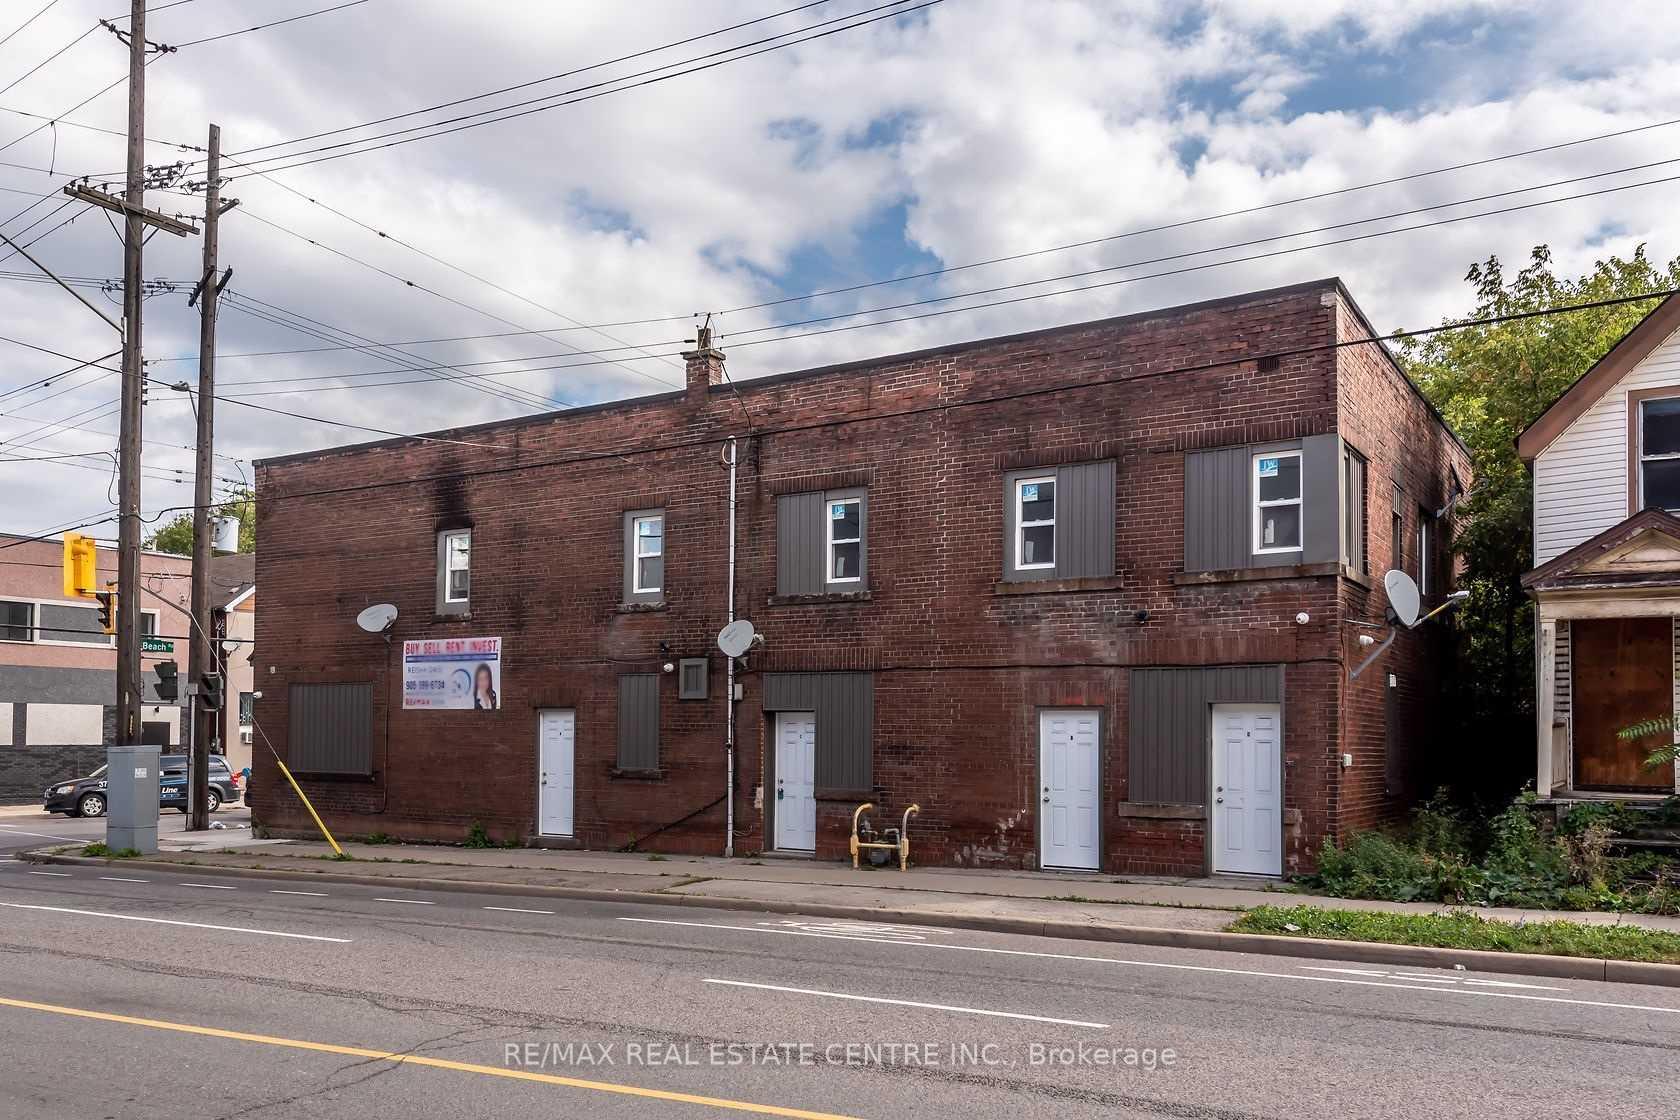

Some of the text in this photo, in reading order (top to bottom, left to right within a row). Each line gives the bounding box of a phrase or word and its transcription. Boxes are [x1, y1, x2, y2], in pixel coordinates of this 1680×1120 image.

[142, 641, 167, 651] Beach
[405, 643, 419, 654] BUY
[423, 642, 441, 654] SELL
